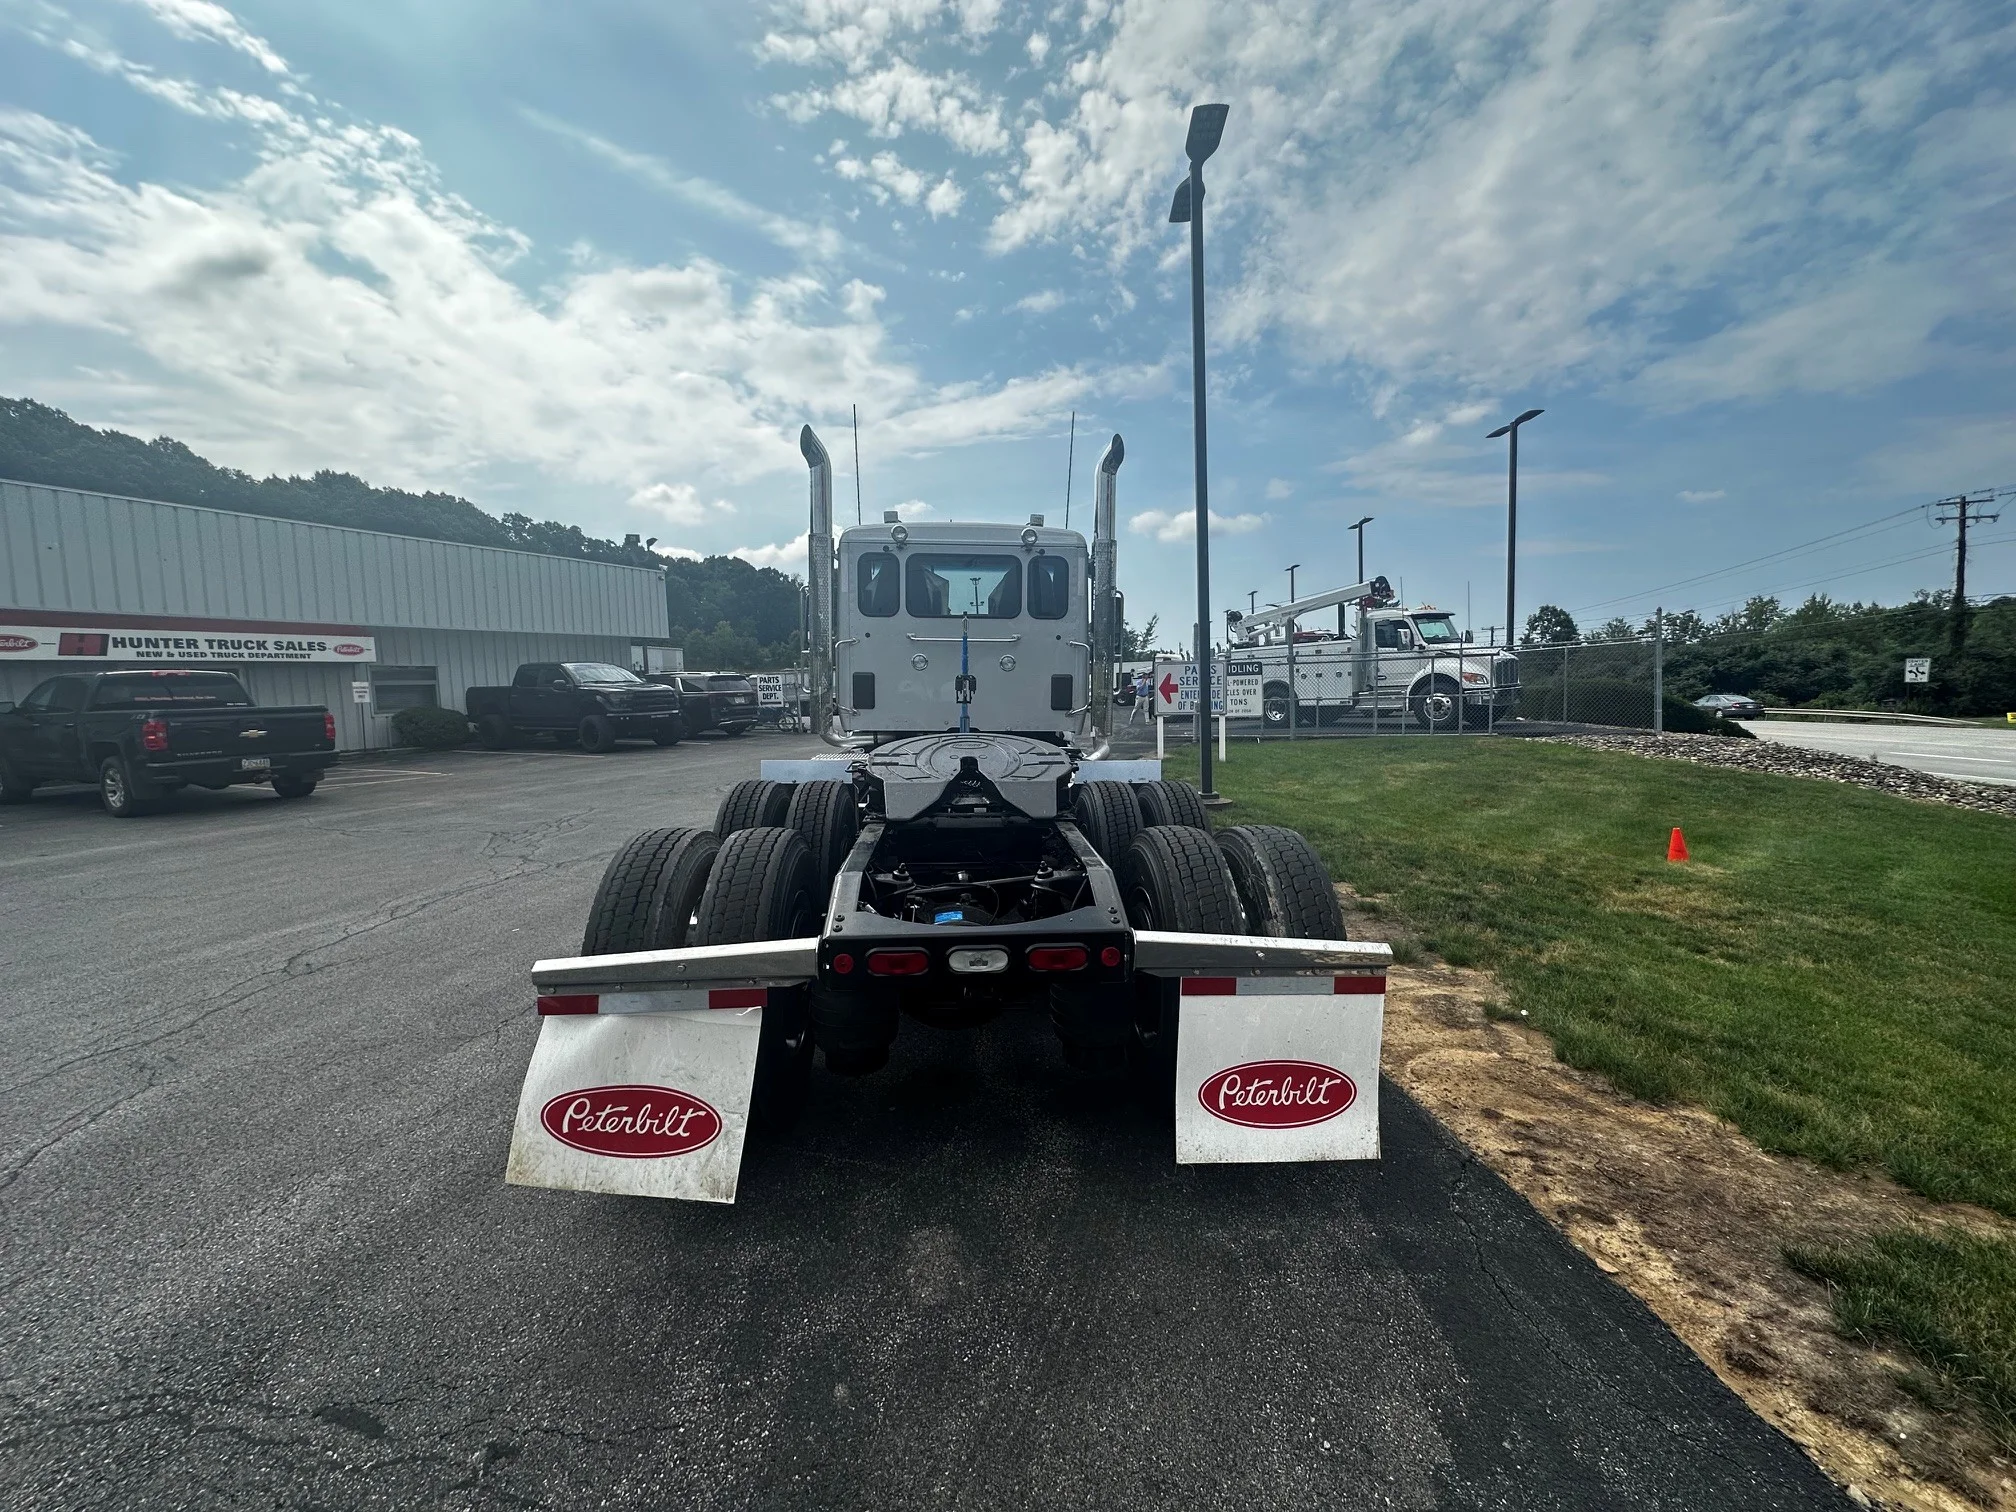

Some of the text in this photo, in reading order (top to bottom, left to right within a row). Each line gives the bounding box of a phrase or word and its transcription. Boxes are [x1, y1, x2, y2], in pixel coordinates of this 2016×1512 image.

[0, 638, 32, 648] erbilt
[111, 636, 327, 652] HUNTER TRUCK SALES
[136, 650, 163, 658] NEW
[178, 651, 208, 659] USED
[210, 651, 246, 659] TRUCK
[248, 652, 312, 660] DEPARTMENT
[1184, 665, 1217, 675] PAS
[1228, 664, 1259, 673] IDLING
[1179, 676, 1222, 686] SERCE
[1180, 690, 1201, 700] ENTE
[1242, 688, 1257, 696] OVER
[1177, 701, 1187, 711] OF
[1230, 698, 1248, 706] TONS
[1218, 1074, 1342, 1111] Peterbilt
[561, 1097, 707, 1137] Peterbilt
